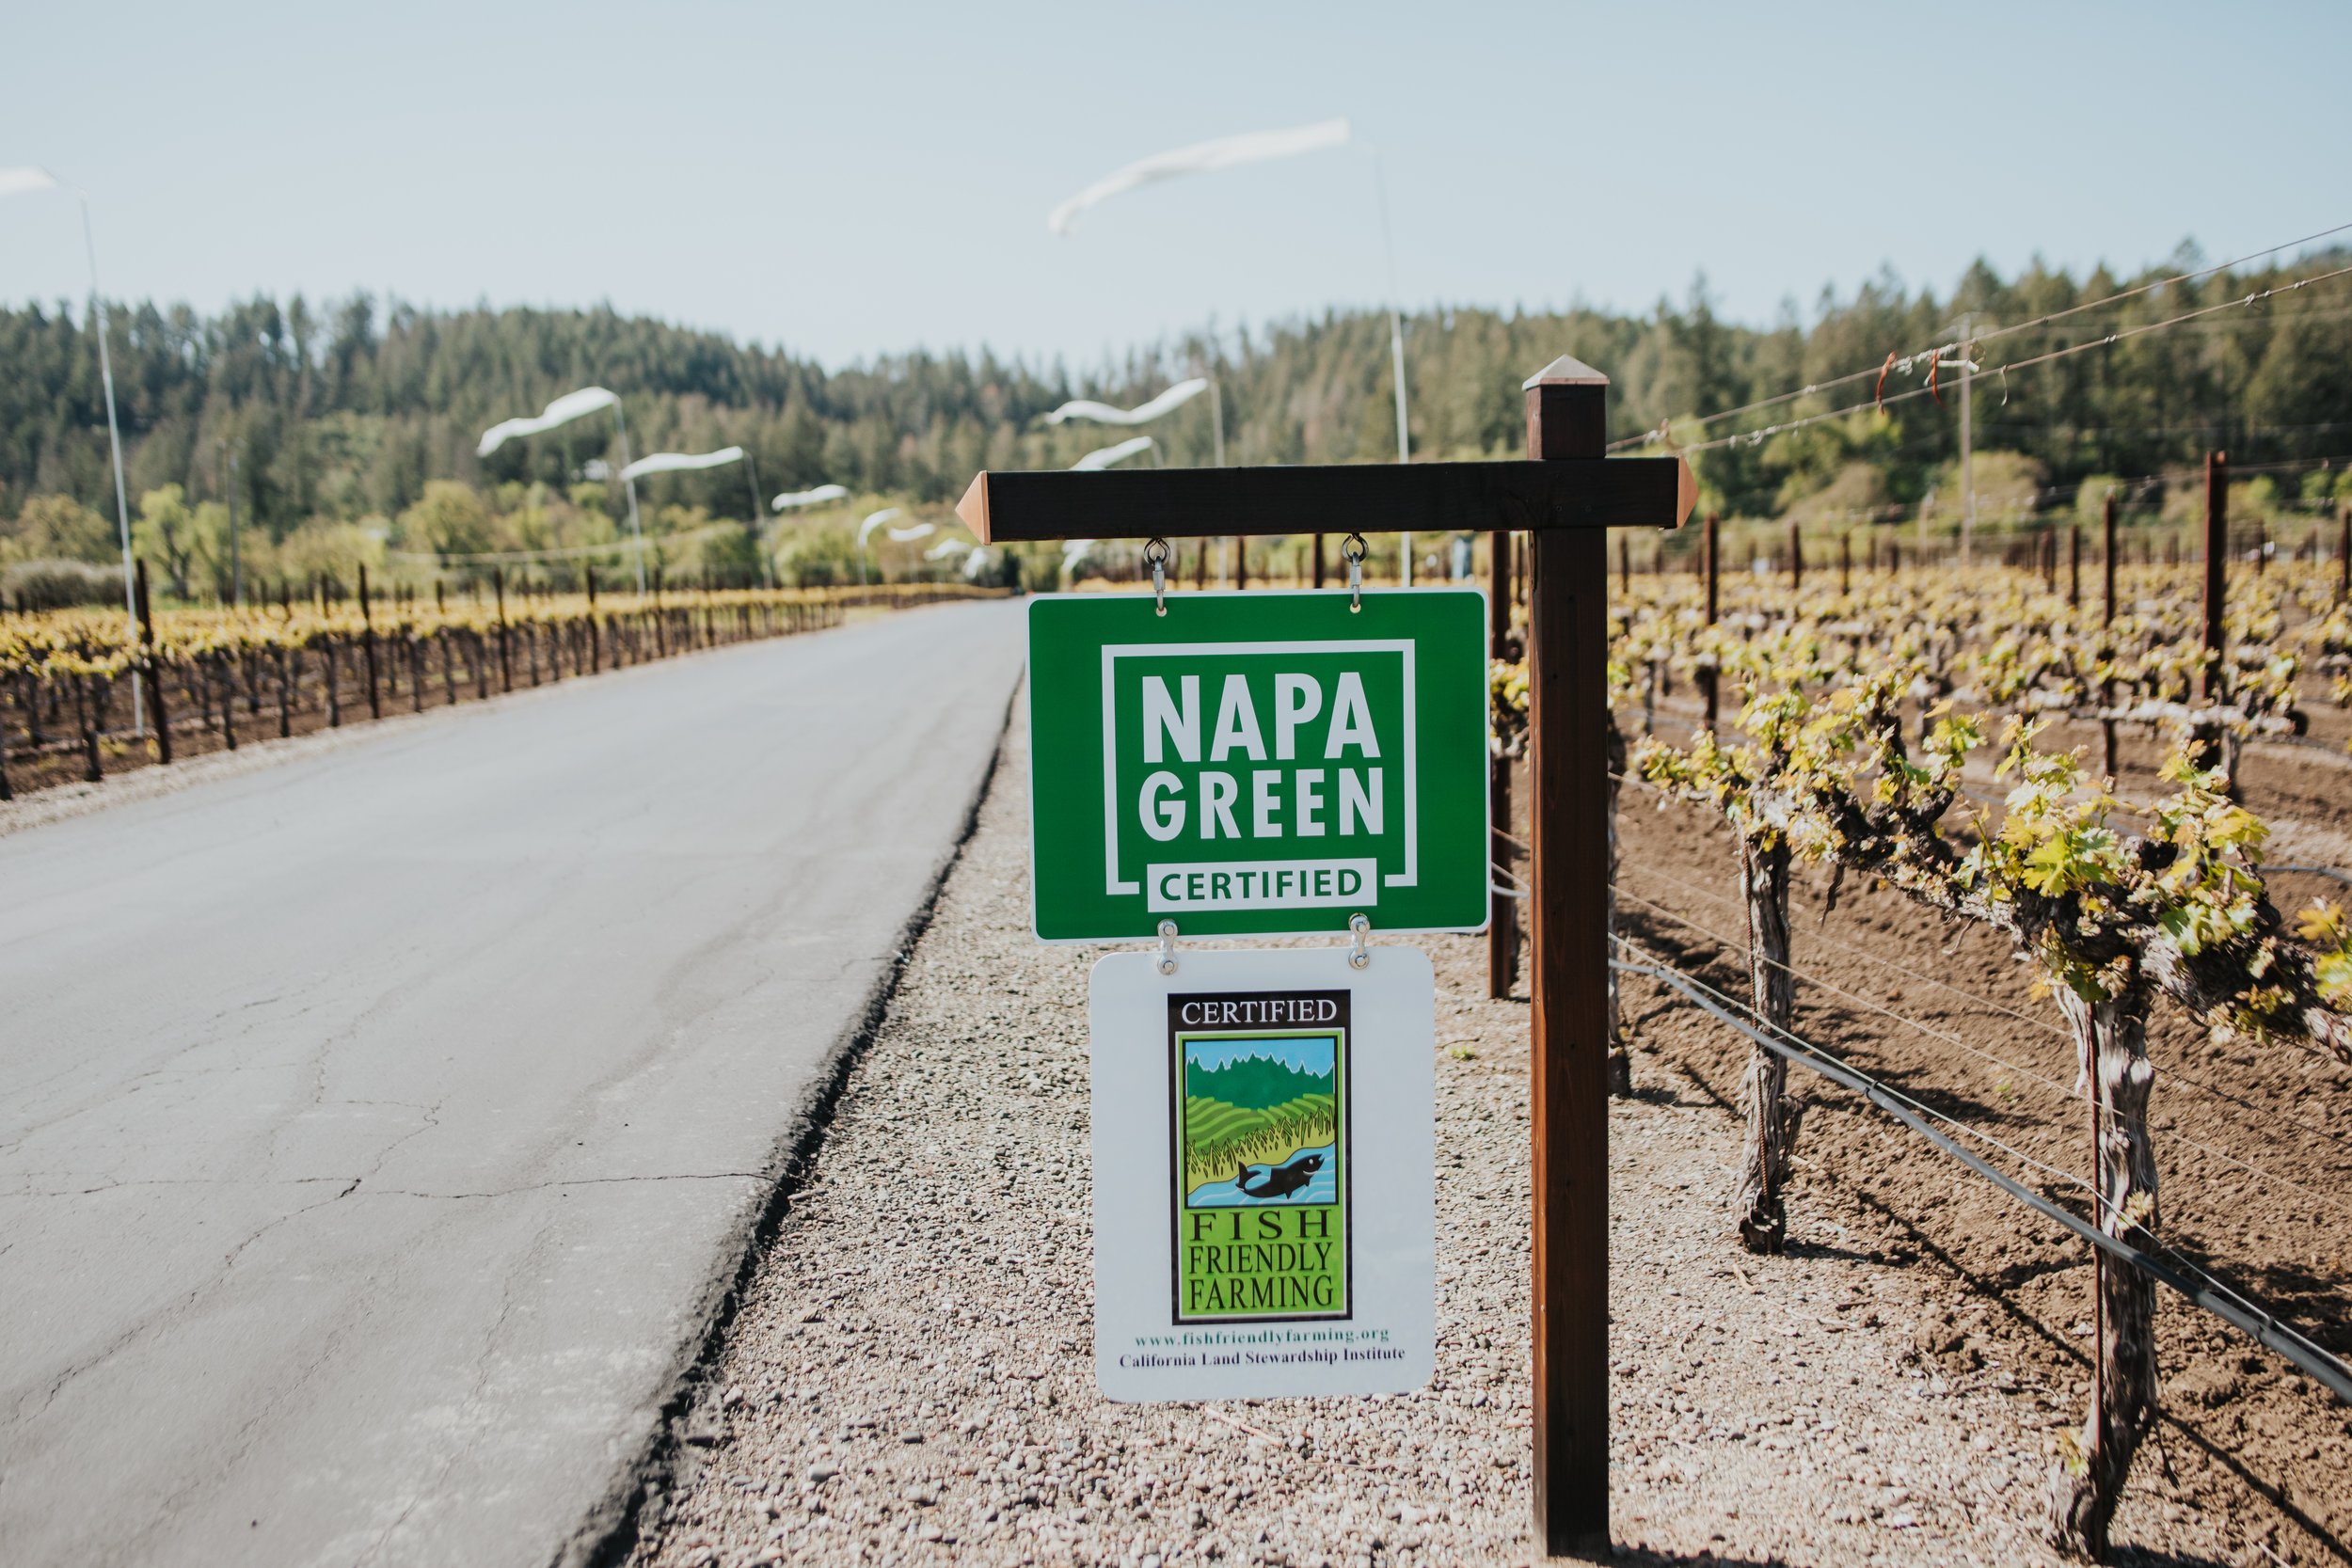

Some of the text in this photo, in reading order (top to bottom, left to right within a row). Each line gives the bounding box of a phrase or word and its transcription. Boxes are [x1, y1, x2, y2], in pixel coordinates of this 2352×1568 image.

[1141, 672, 1381, 763] NAPA
[1138, 767, 1384, 842] GREEN
[1159, 868, 1362, 901] CERTIFIED
[1181, 999, 1337, 1025] CERTIFIED
[1189, 1209, 1332, 1242] FISH
[1188, 1242, 1333, 1275] FRIENDLY
[1188, 1274, 1334, 1310] FARMING
[1135, 1327, 1390, 1347] www.fishfriendlyfarming.org
[1120, 1347, 1406, 1369] California Land Stewardship Institute
